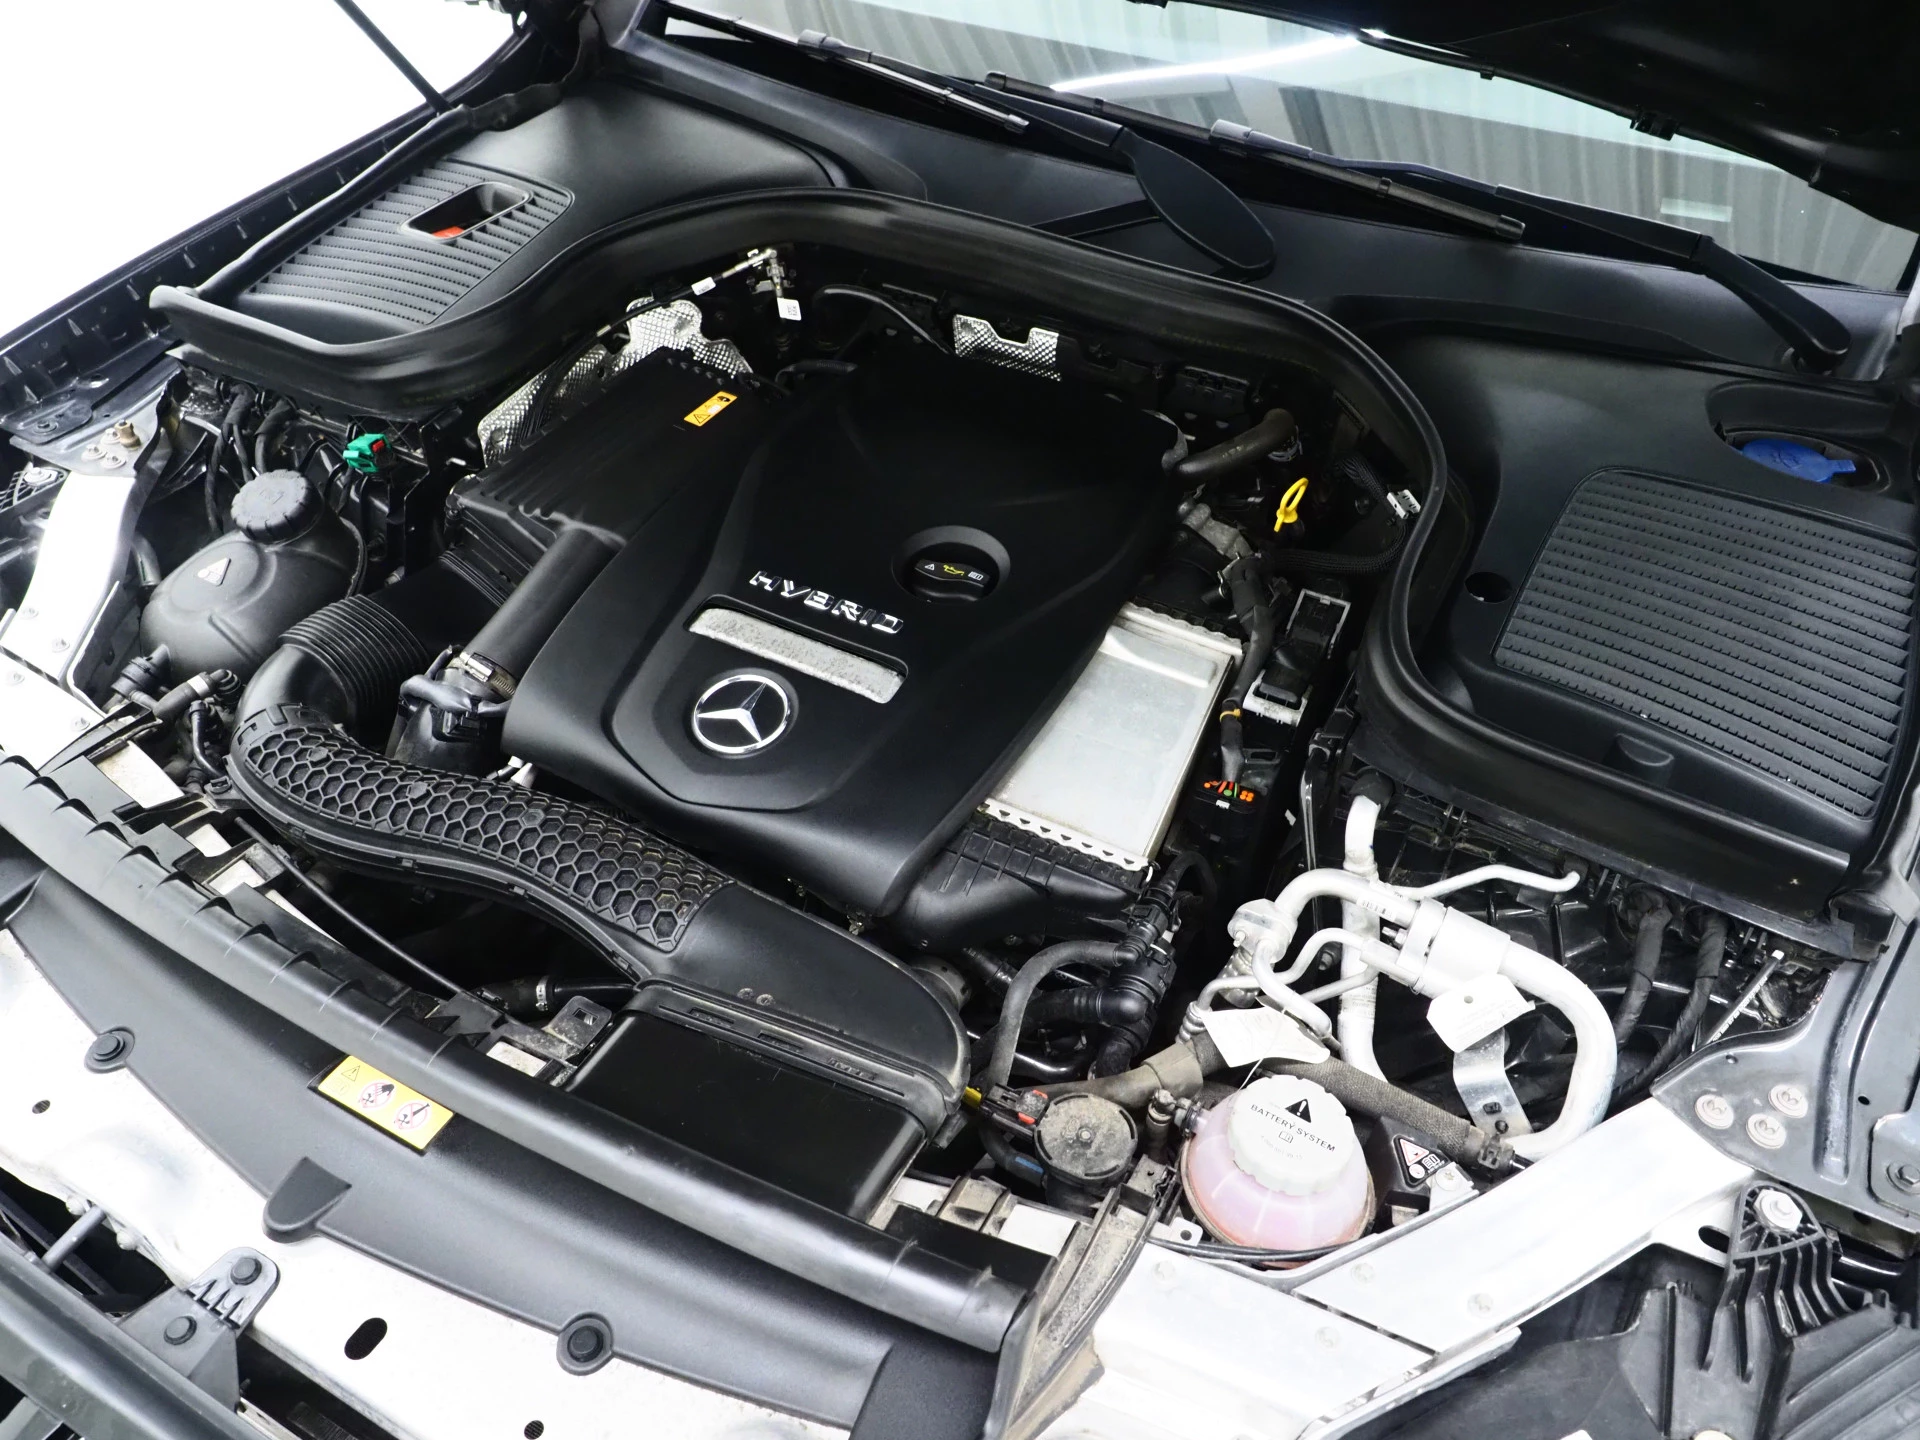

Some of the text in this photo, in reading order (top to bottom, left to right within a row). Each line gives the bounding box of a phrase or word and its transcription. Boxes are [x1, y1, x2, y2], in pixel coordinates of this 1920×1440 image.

[749, 570, 904, 634] HYBRID
[1250, 1104, 1295, 1130] BATTERY
[1296, 1127, 1336, 1152] SYSTEM
